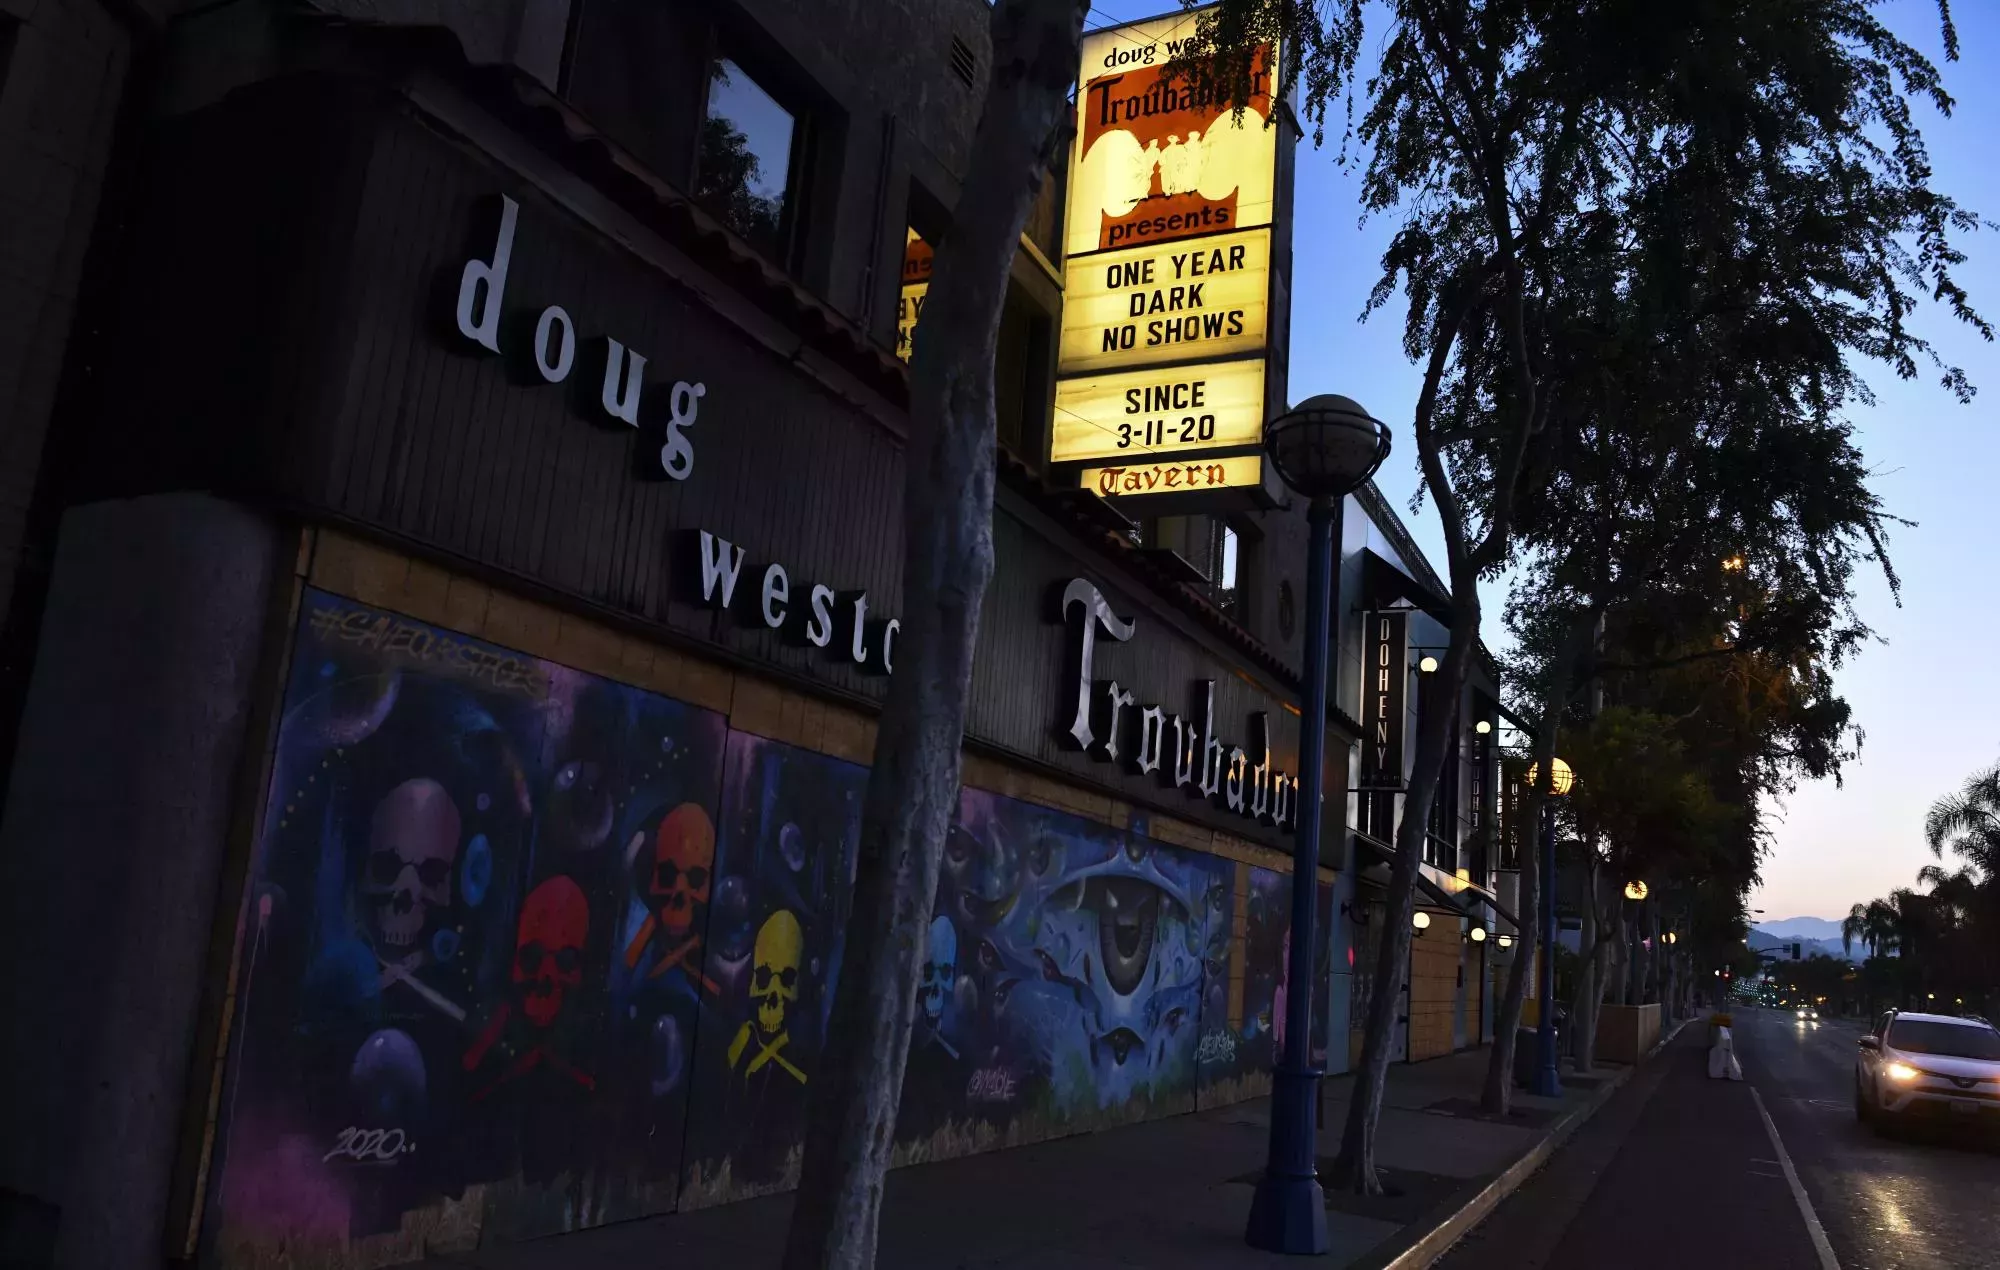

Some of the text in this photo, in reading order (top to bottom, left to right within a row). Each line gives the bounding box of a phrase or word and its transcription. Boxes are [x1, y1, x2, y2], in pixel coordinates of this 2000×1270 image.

[1104, 43, 1156, 69] doug
[1109, 206, 1230, 245] presents
[1106, 245, 1246, 289] ONE YEAR
[1130, 283, 1205, 317] DARK
[456, 192, 707, 481] doug
[1102, 310, 1244, 353] NO SHOWS
[1125, 381, 1206, 415] SINCE
[1117, 414, 1216, 449] 3-11-20
[1099, 463, 1226, 497] Tavern
[1376, 617, 1391, 771] DOHENY
